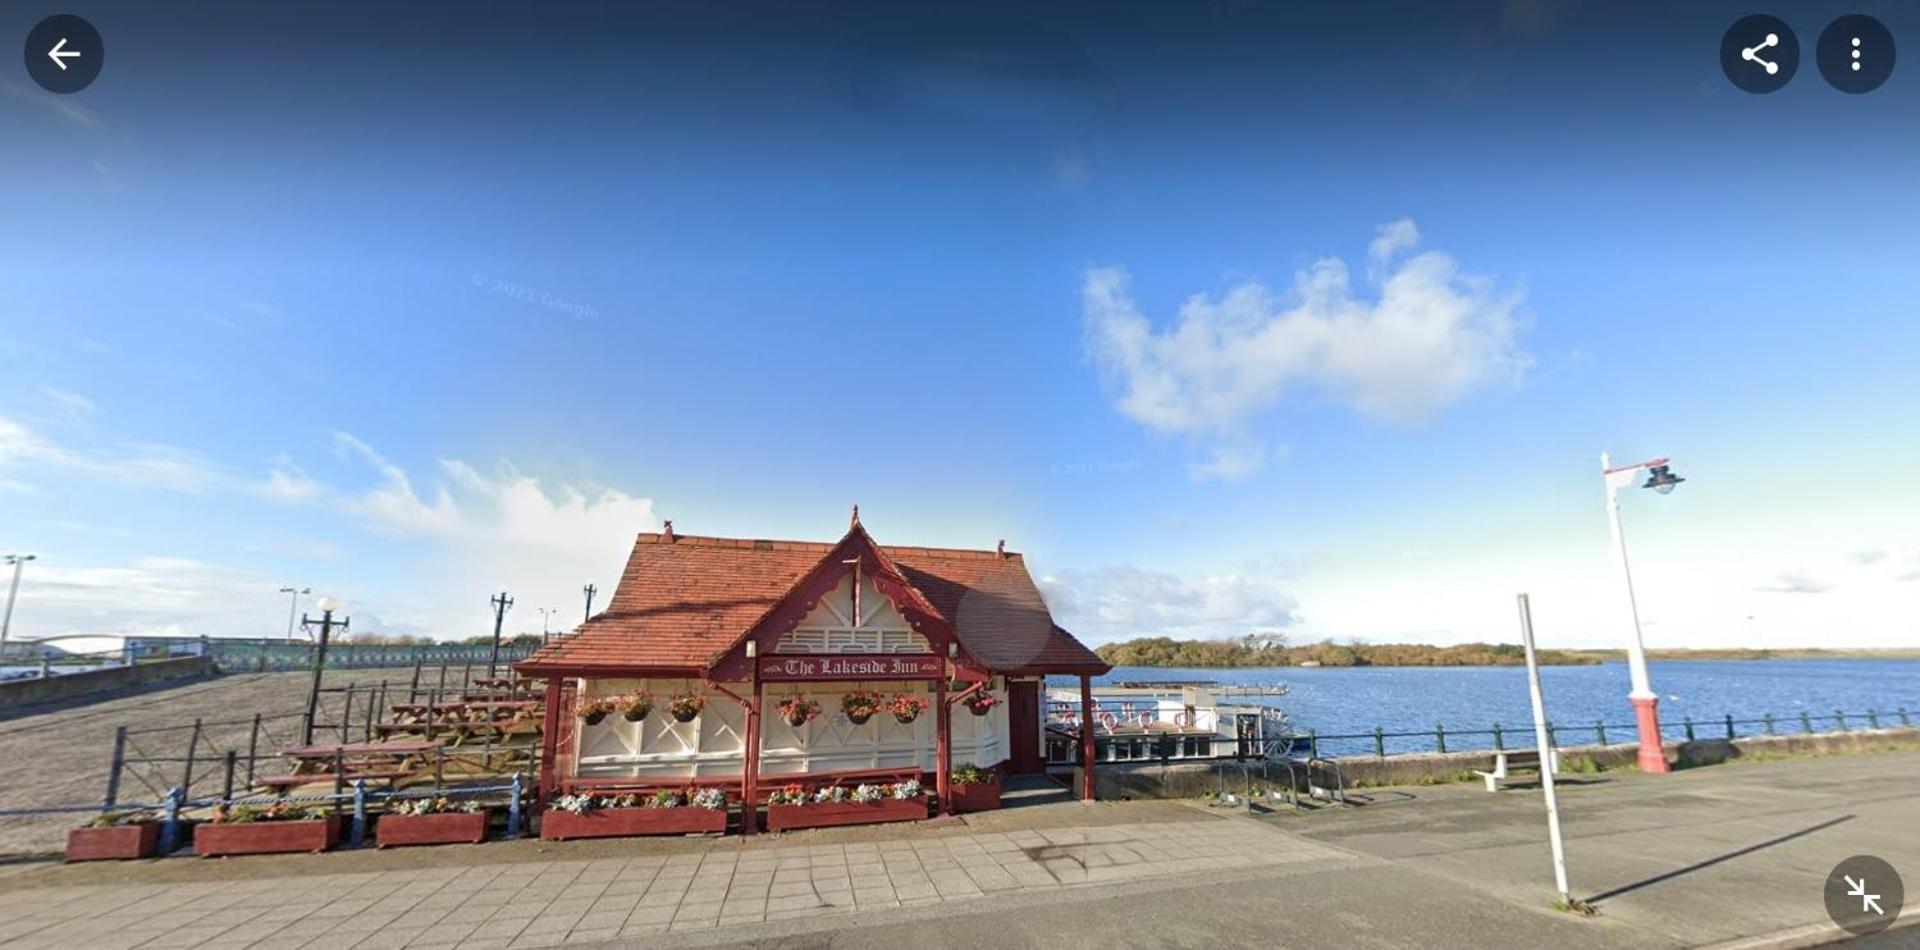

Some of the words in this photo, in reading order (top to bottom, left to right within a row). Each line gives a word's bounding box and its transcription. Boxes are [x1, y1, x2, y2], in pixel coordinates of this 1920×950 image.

[785, 659, 815, 676] The
[820, 658, 887, 674] Lakeside
[891, 657, 919, 674] Inn
